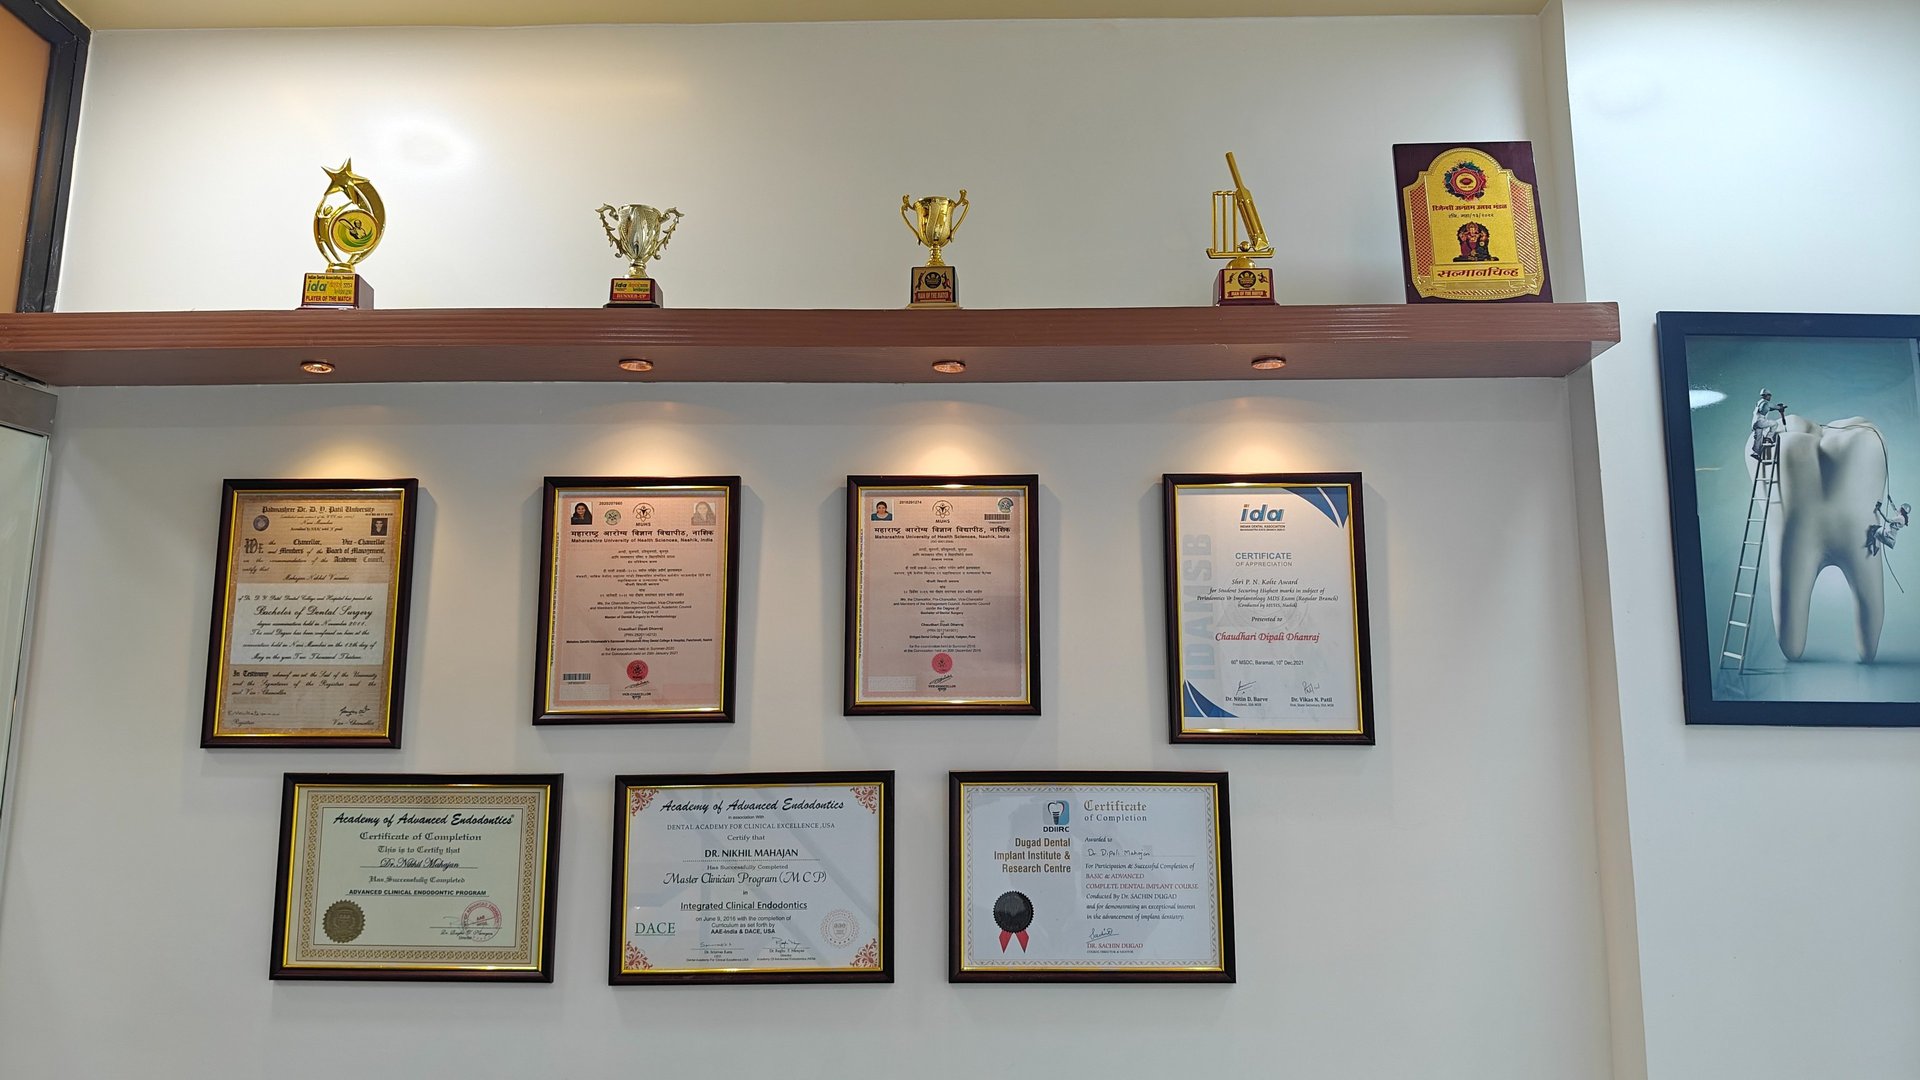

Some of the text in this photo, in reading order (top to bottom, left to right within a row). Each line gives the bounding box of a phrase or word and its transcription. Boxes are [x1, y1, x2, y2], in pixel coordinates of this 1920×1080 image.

[307, 280, 327, 291] ida
[1241, 504, 1284, 521] ida
[254, 605, 373, 620] Bachelor of Dental Surgery
[1216, 632, 1320, 643] Chaudhari Dipali Dhanraj
[660, 798, 844, 814] Academy of Advanced Endodontics
[1084, 800, 1147, 811] Certificate
[333, 812, 381, 826] Academy
[382, 814, 394, 827] of
[397, 814, 448, 825] Advanced
[1096, 814, 1147, 823] Completion
[360, 832, 482, 842] Certificate of Completion
[1015, 838, 1071, 848] Dugad Dental
[378, 846, 460, 854] This is to Certify that
[705, 849, 799, 859] DR. NIKHIL MAHAJAN
[994, 851, 1070, 862] Implant Institute &
[1002, 864, 1071, 872] Research Centre
[1134, 863, 1159, 871] Successful
[1190, 863, 1195, 871] of
[385, 876, 428, 884] Successfully
[663, 873, 698, 885] Master
[701, 872, 735, 884] Clinician
[737, 872, 777, 887] Program
[680, 901, 807, 911] Integrated Clinical Endodontics
[635, 923, 675, 933] DACE
